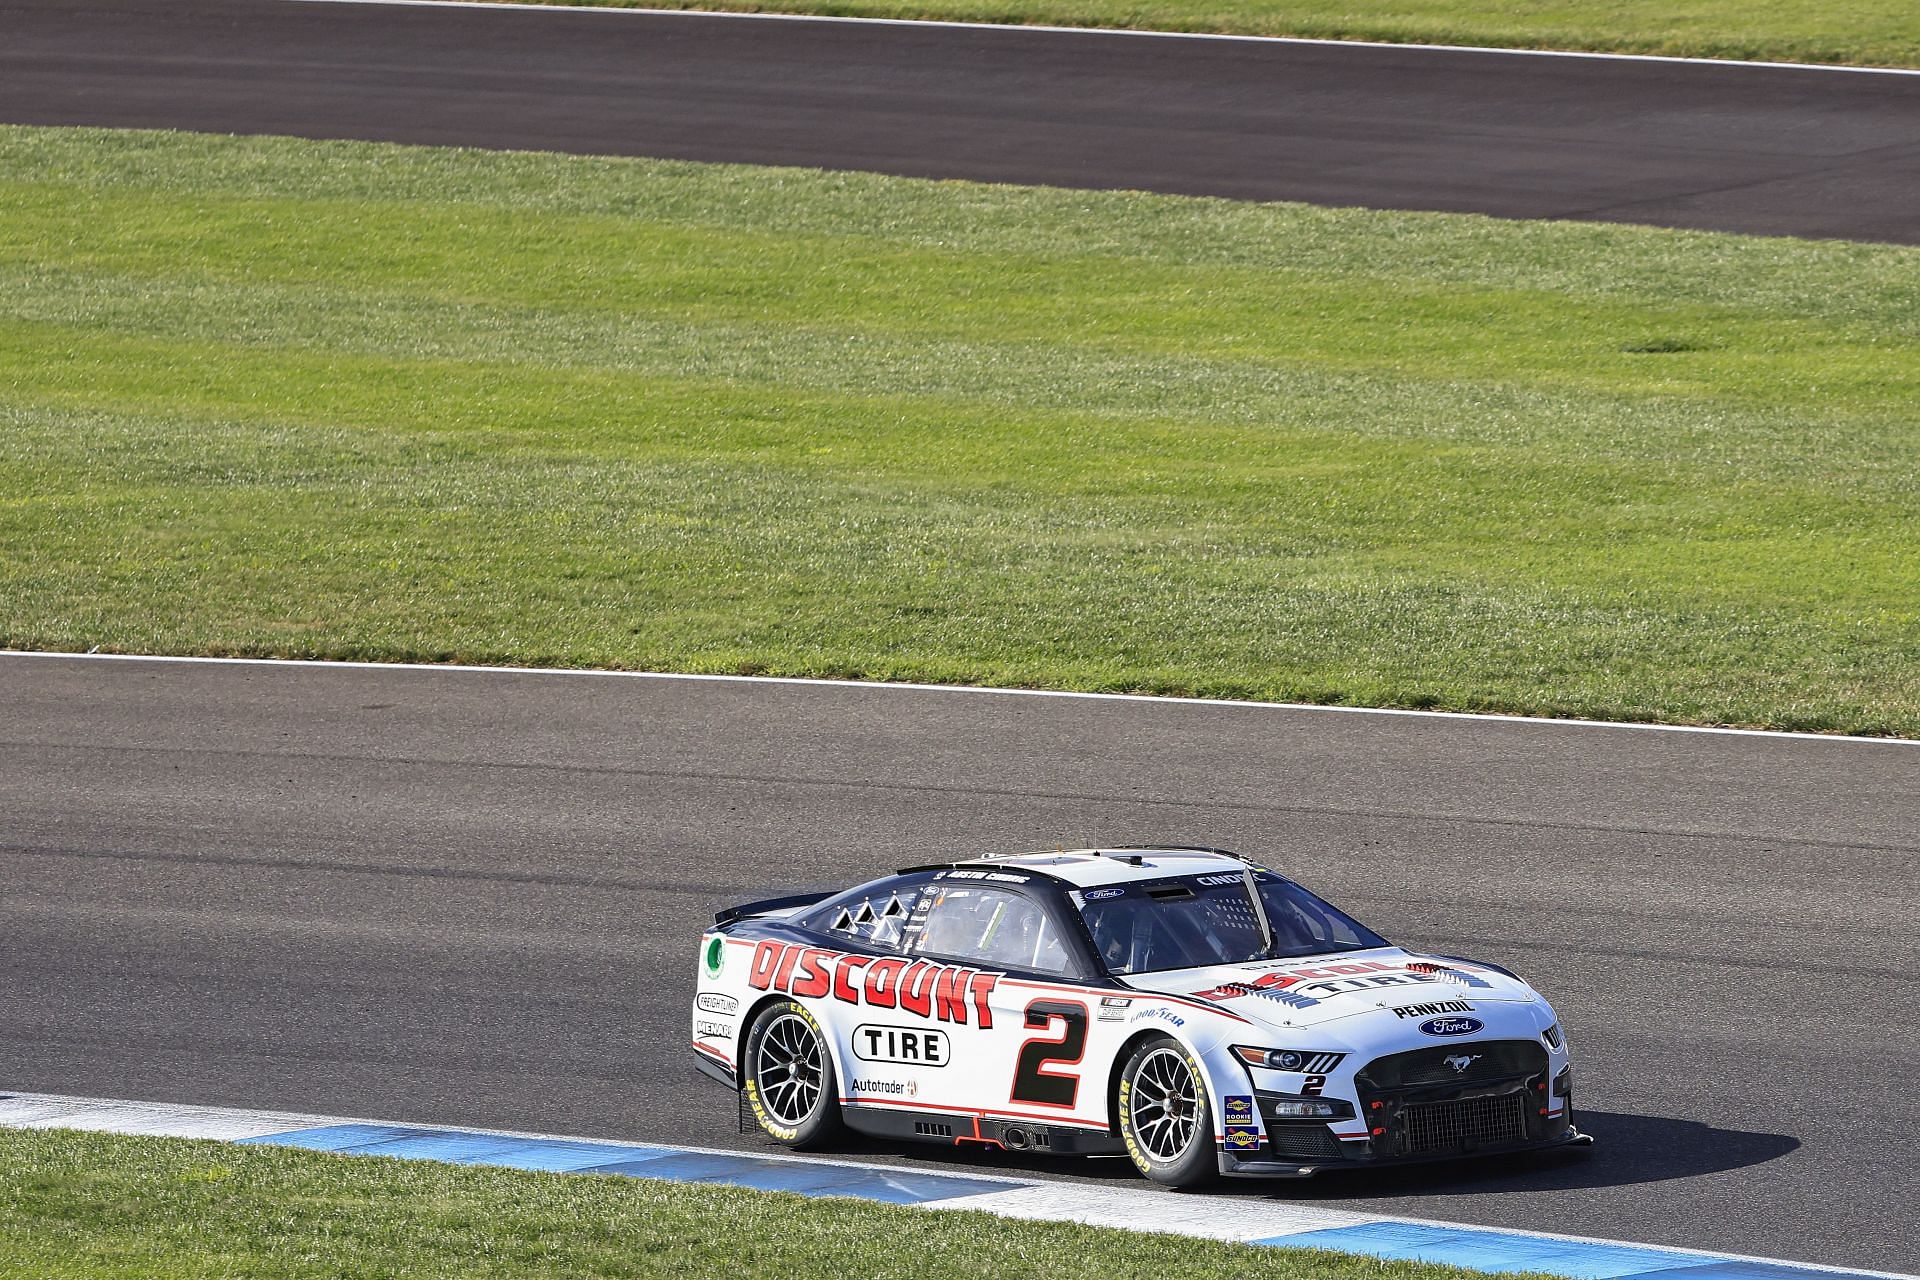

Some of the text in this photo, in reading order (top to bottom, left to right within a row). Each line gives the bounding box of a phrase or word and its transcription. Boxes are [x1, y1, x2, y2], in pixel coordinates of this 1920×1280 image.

[748, 939, 997, 1028] DISCOUNT
[790, 1002, 819, 1033] EAGLE
[1392, 1000, 1476, 1020] PENNZOIL
[1433, 1019, 1472, 1034] Ford
[864, 1029, 940, 1061] TIRE
[1009, 997, 1089, 1110] 2
[851, 1078, 904, 1094] Autotrader
[1300, 1075, 1326, 1096] 2
[1119, 1079, 1151, 1173] GOODYEAR
[1226, 1135, 1258, 1143] SUNOCO
